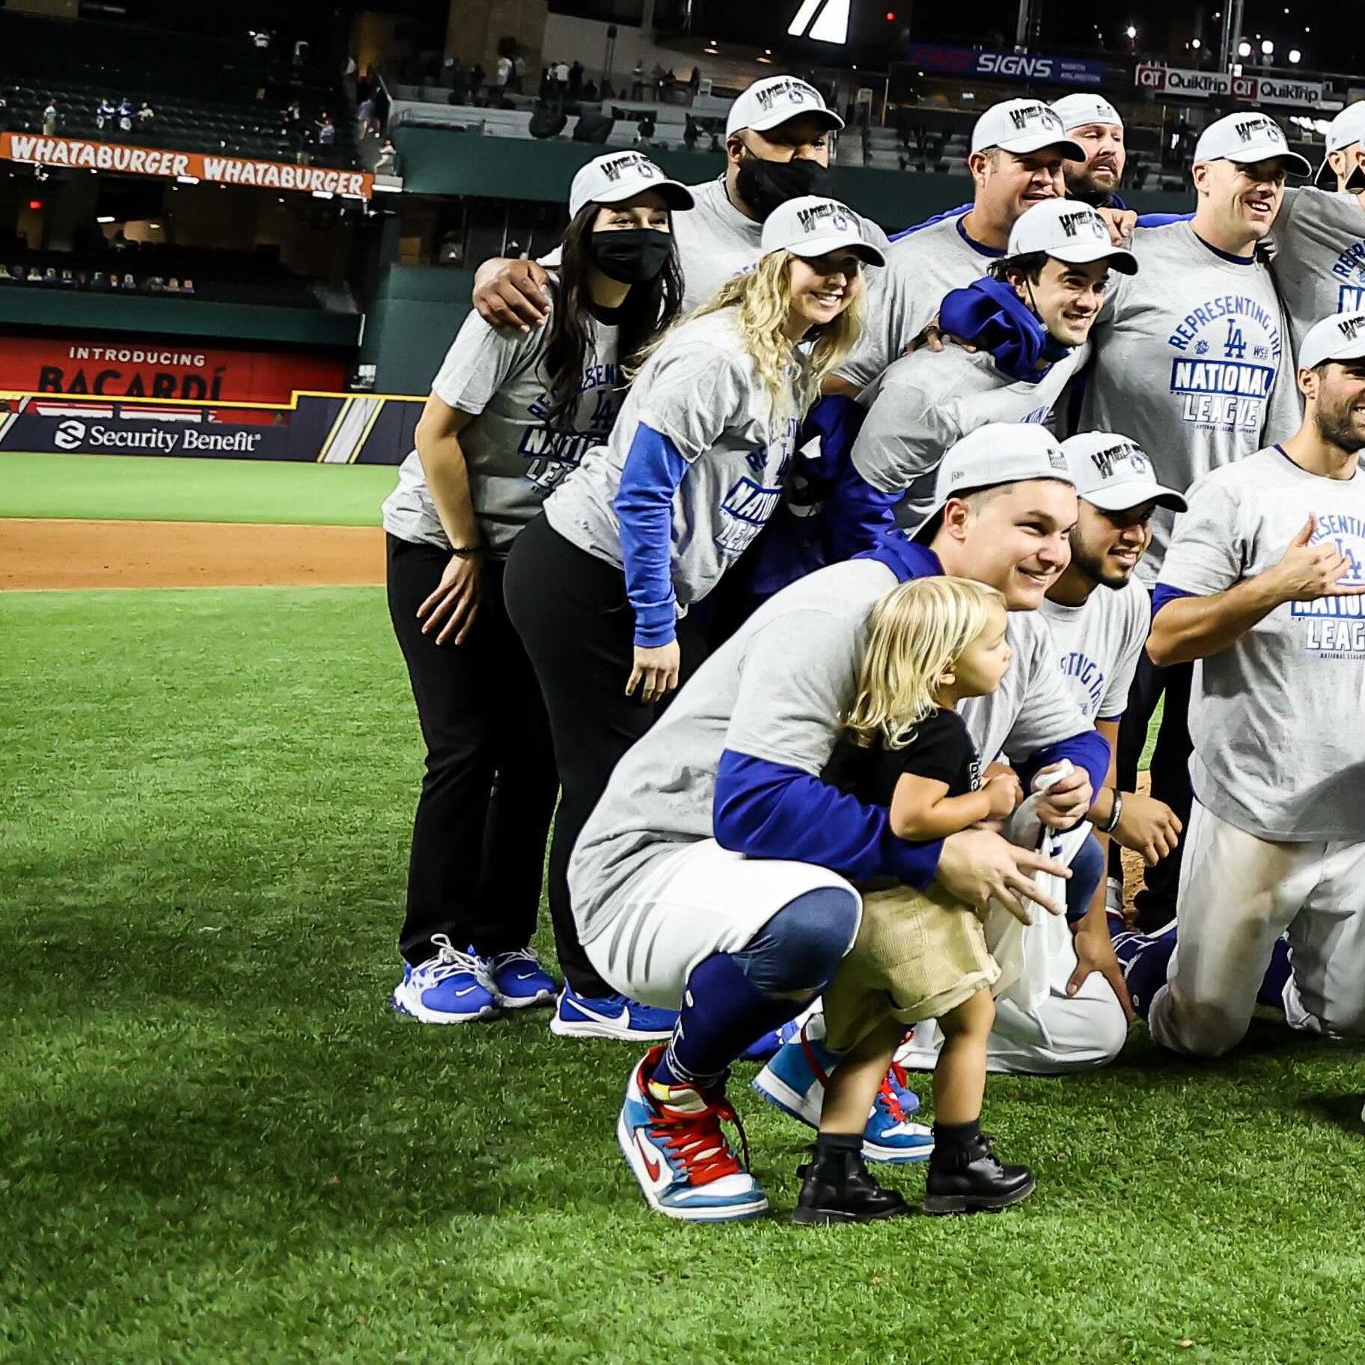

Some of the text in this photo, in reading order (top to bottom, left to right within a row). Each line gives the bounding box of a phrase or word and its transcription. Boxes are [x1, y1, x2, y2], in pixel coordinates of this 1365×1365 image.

[1169, 72, 1229, 94] QuikTrip
[1259, 80, 1320, 102] QuikTrip
[9, 136, 189, 177] WHATABURGER
[203, 158, 364, 195] WHATABURGER
[1168, 295, 1283, 361] REPRESENTING THE
[1224, 318, 1247, 359] LA
[69, 346, 206, 367] INTRODUCING
[38, 365, 227, 400] BACARDÍ
[1173, 361, 1269, 396] NATIONAL
[1182, 393, 1261, 427] LEAGUE
[89, 427, 179, 453] Security
[1335, 537, 1362, 579] LA
